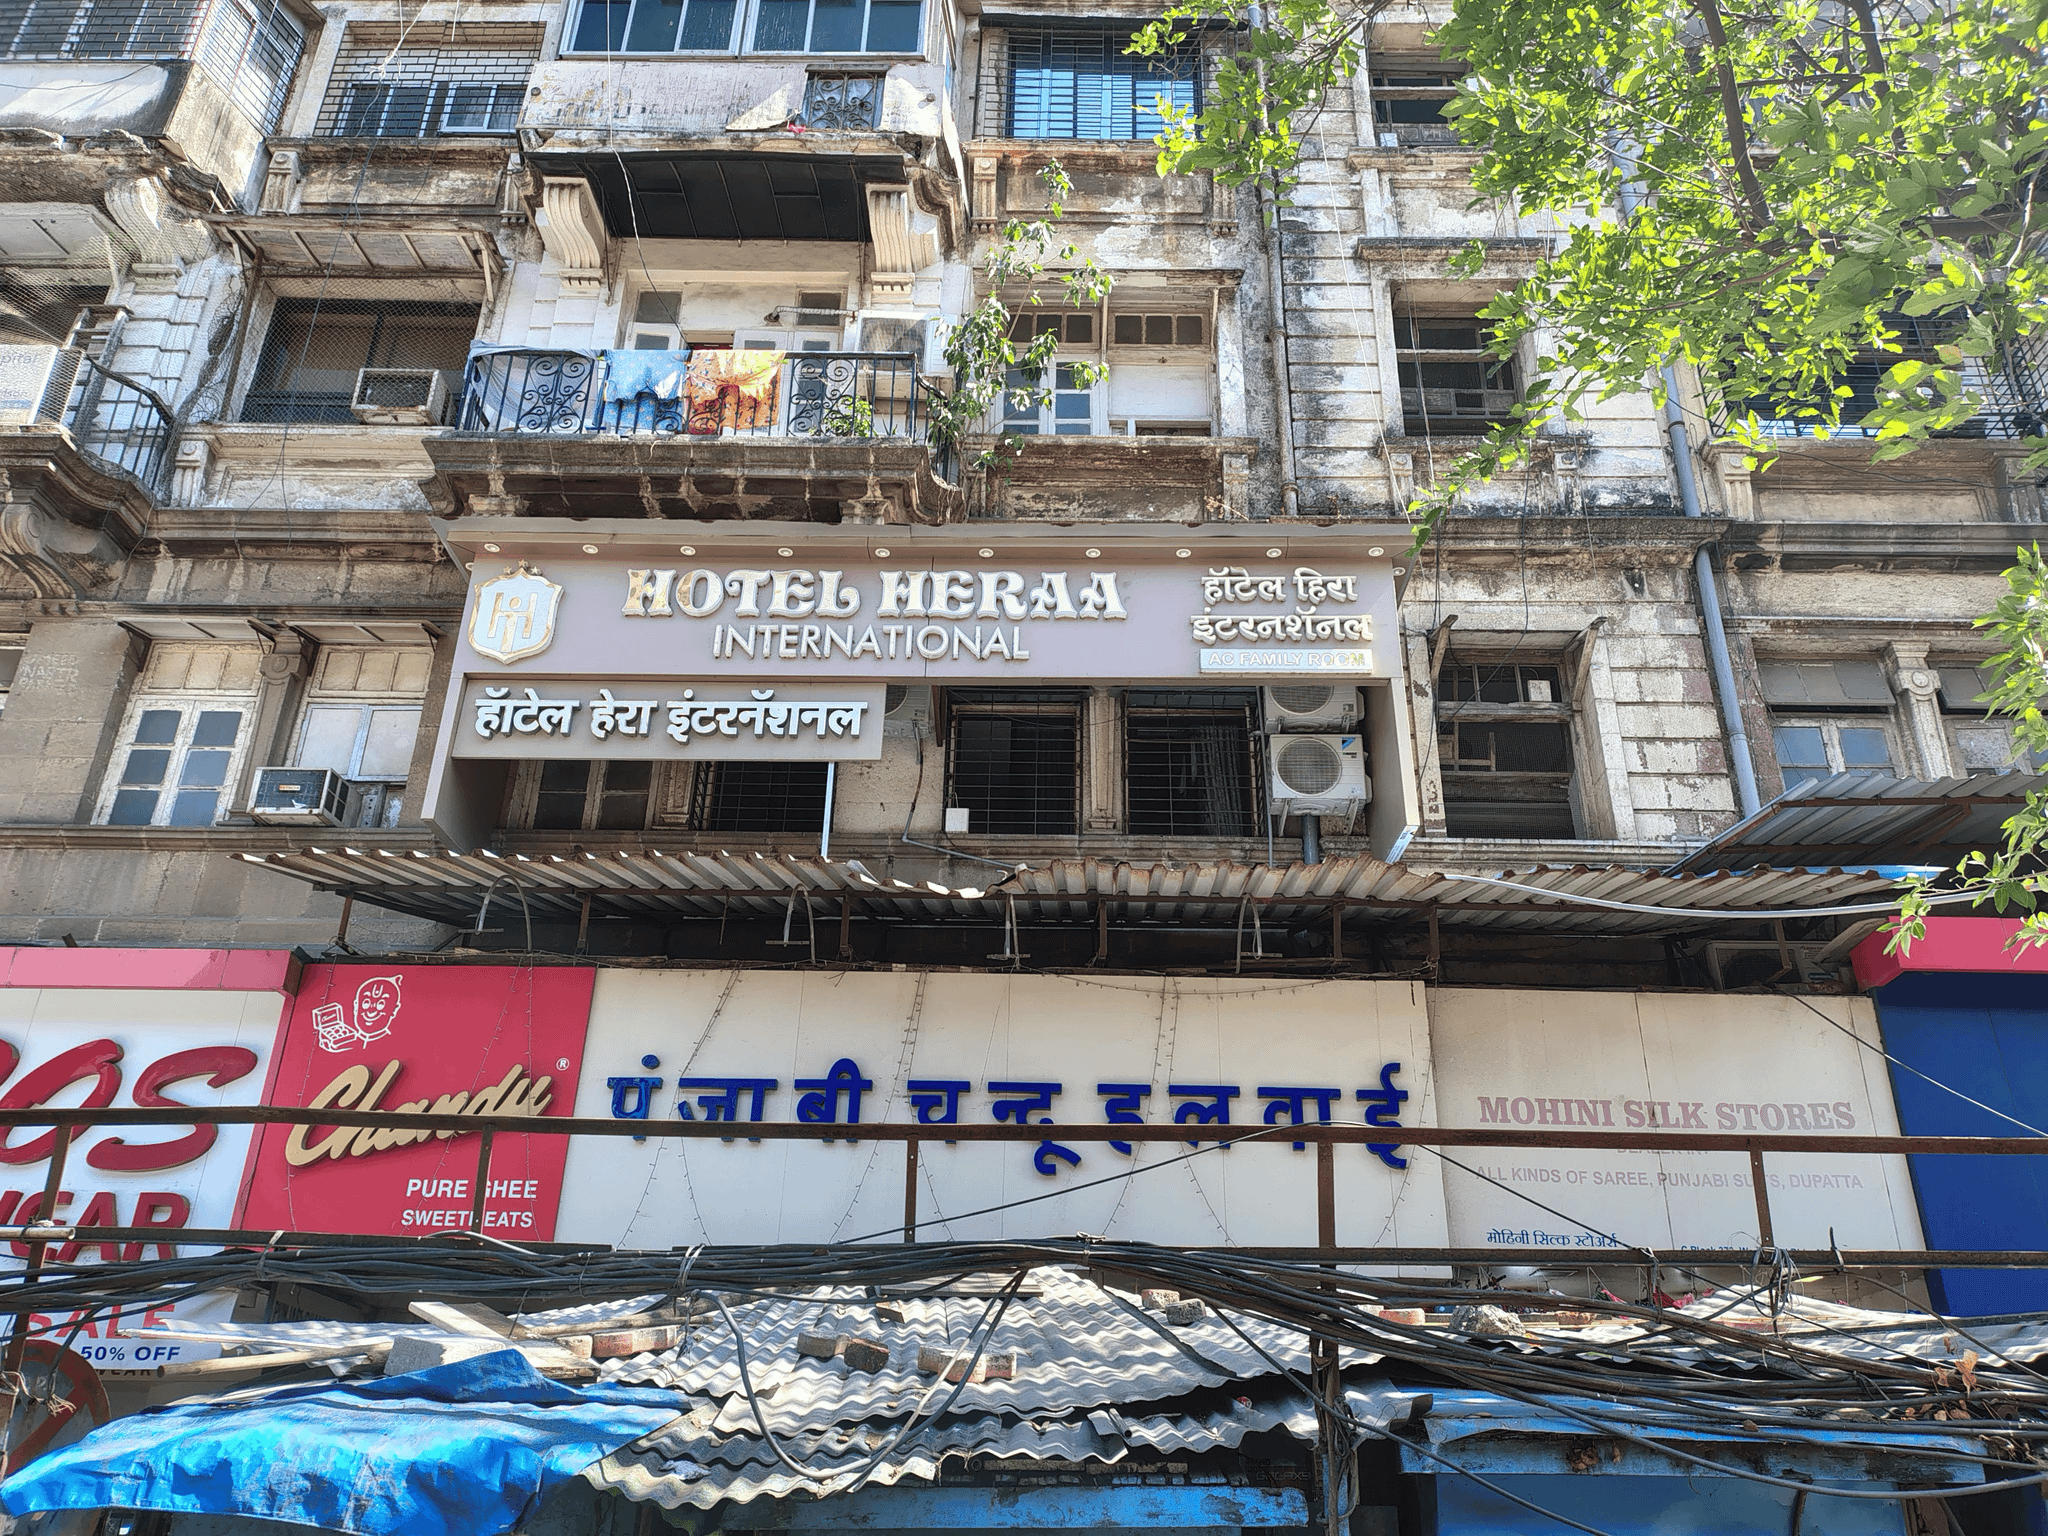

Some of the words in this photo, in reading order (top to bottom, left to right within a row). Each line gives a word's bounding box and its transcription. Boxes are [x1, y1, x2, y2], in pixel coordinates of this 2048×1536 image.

[621, 569, 860, 617] HOTEL
[877, 571, 1128, 619] HERAA
[1202, 566, 1286, 605] हॉटेल
[1292, 567, 1358, 604] हिरा
[712, 624, 1029, 660] INTERNATIONAL
[1209, 652, 1234, 665] AC
[1240, 652, 1303, 666] FAMILY
[1308, 653, 1365, 666] ROOM
[474, 687, 580, 739] हॉटेल
[590, 689, 658, 740] हेरा
[1477, 1096, 1615, 1126] MOHINI
[1625, 1099, 1708, 1130] SILK
[1715, 1102, 1856, 1131] STORES
[406, 1179, 469, 1198] PURE
[1476, 1166, 1507, 1181] ALL
[1511, 1167, 1561, 1183] KINDS
[1566, 1169, 1588, 1184] OF
[1593, 1171, 1654, 1188] SAREE,
[1658, 1173, 1729, 1188] PUNJABI
[1789, 1174, 1864, 1189] DUPATTA
[1486, 1228, 1530, 1245] मोहिनी
[1533, 1229, 1571, 1246] सिल्क
[80, 1346, 125, 1361] 50%
[134, 1346, 180, 1361] OFF
